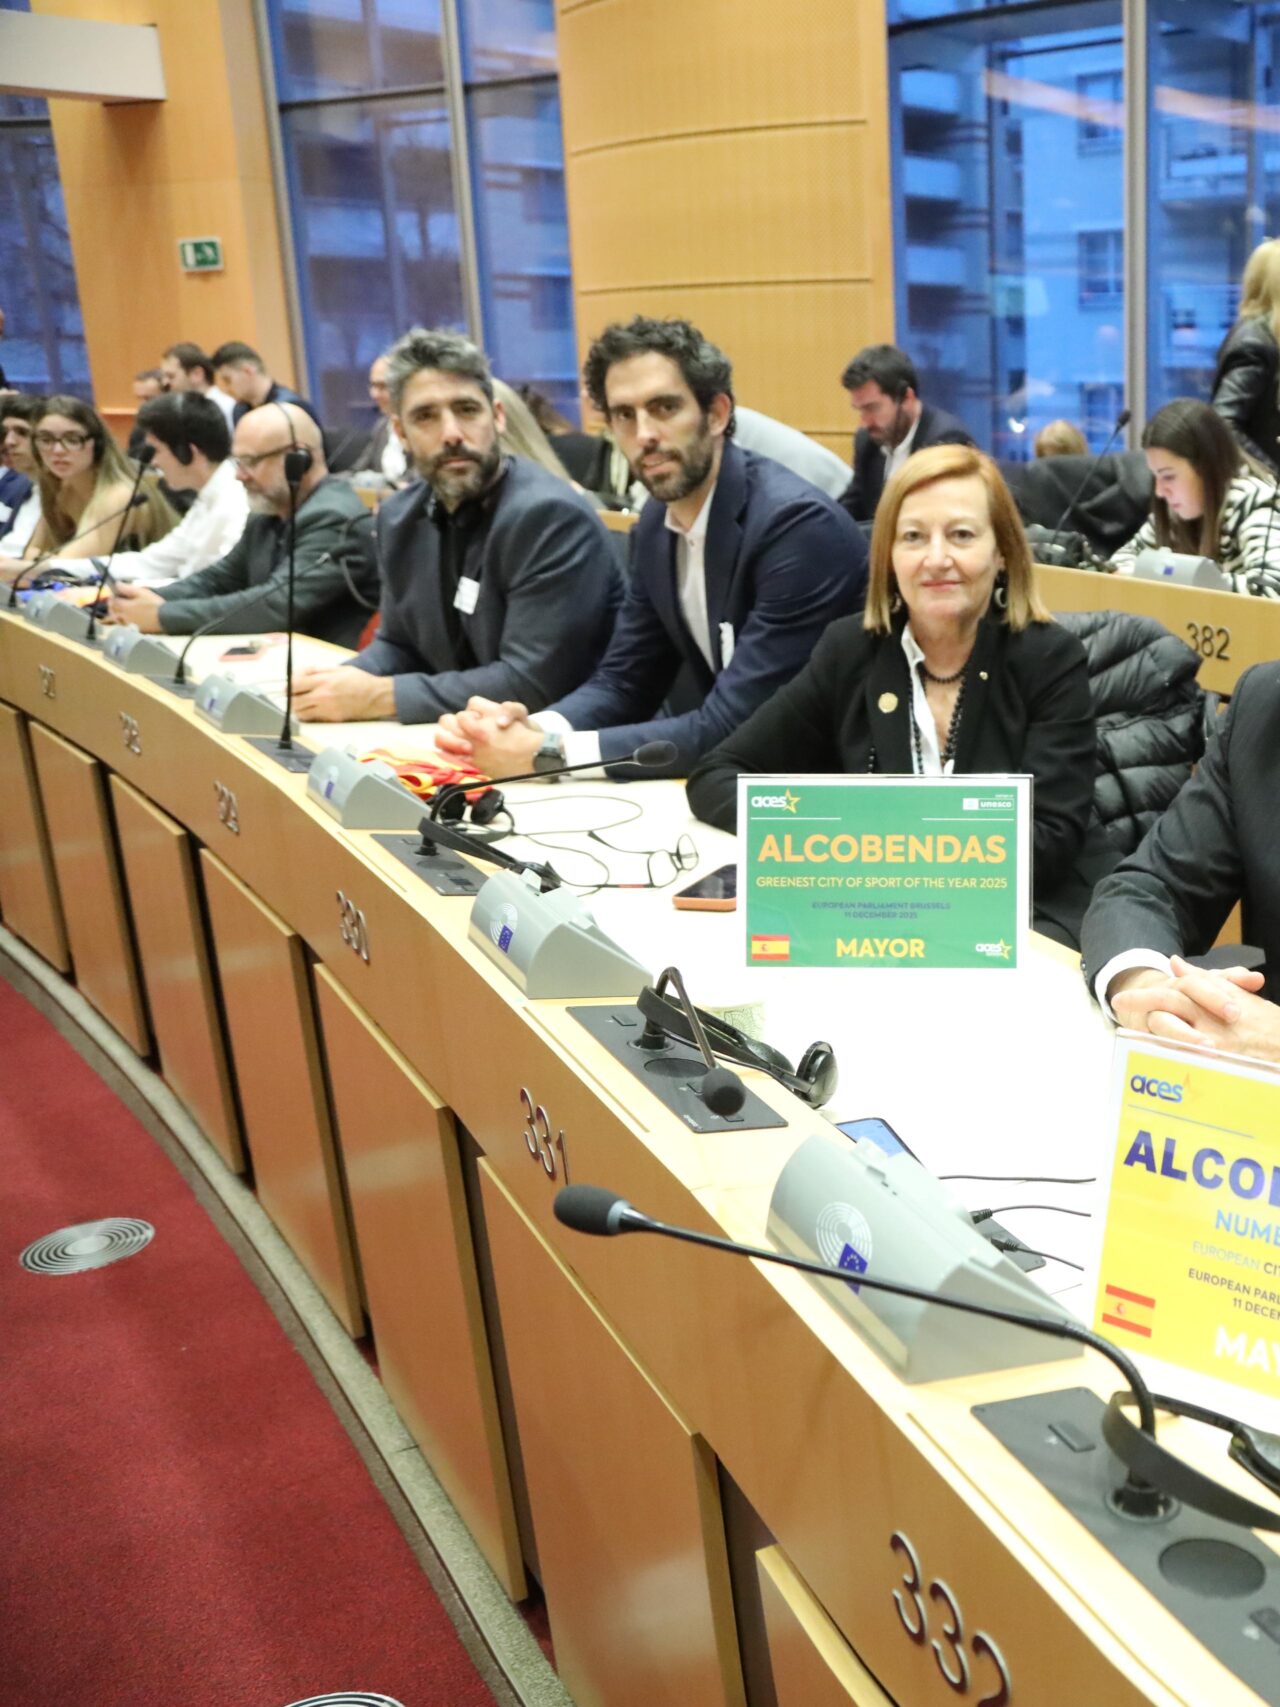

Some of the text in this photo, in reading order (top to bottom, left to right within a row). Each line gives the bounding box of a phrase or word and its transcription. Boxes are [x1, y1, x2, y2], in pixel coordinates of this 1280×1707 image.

[1186, 622, 1231, 661] 382
[751, 796, 787, 808] aces
[980, 800, 1012, 809] unesco
[757, 833, 1007, 864] ALCOBENDAS
[756, 876, 1008, 889] GREENEST CITY OF SPORT OF THE YEAR 2025
[836, 937, 925, 958] MAYOR
[1130, 1073, 1184, 1103] aces
[520, 1087, 569, 1186] 331
[1192, 1241, 1260, 1270] EUROPEAN
[1188, 1268, 1251, 1296] EUROPEAN
[1233, 1297, 1243, 1309] 11
